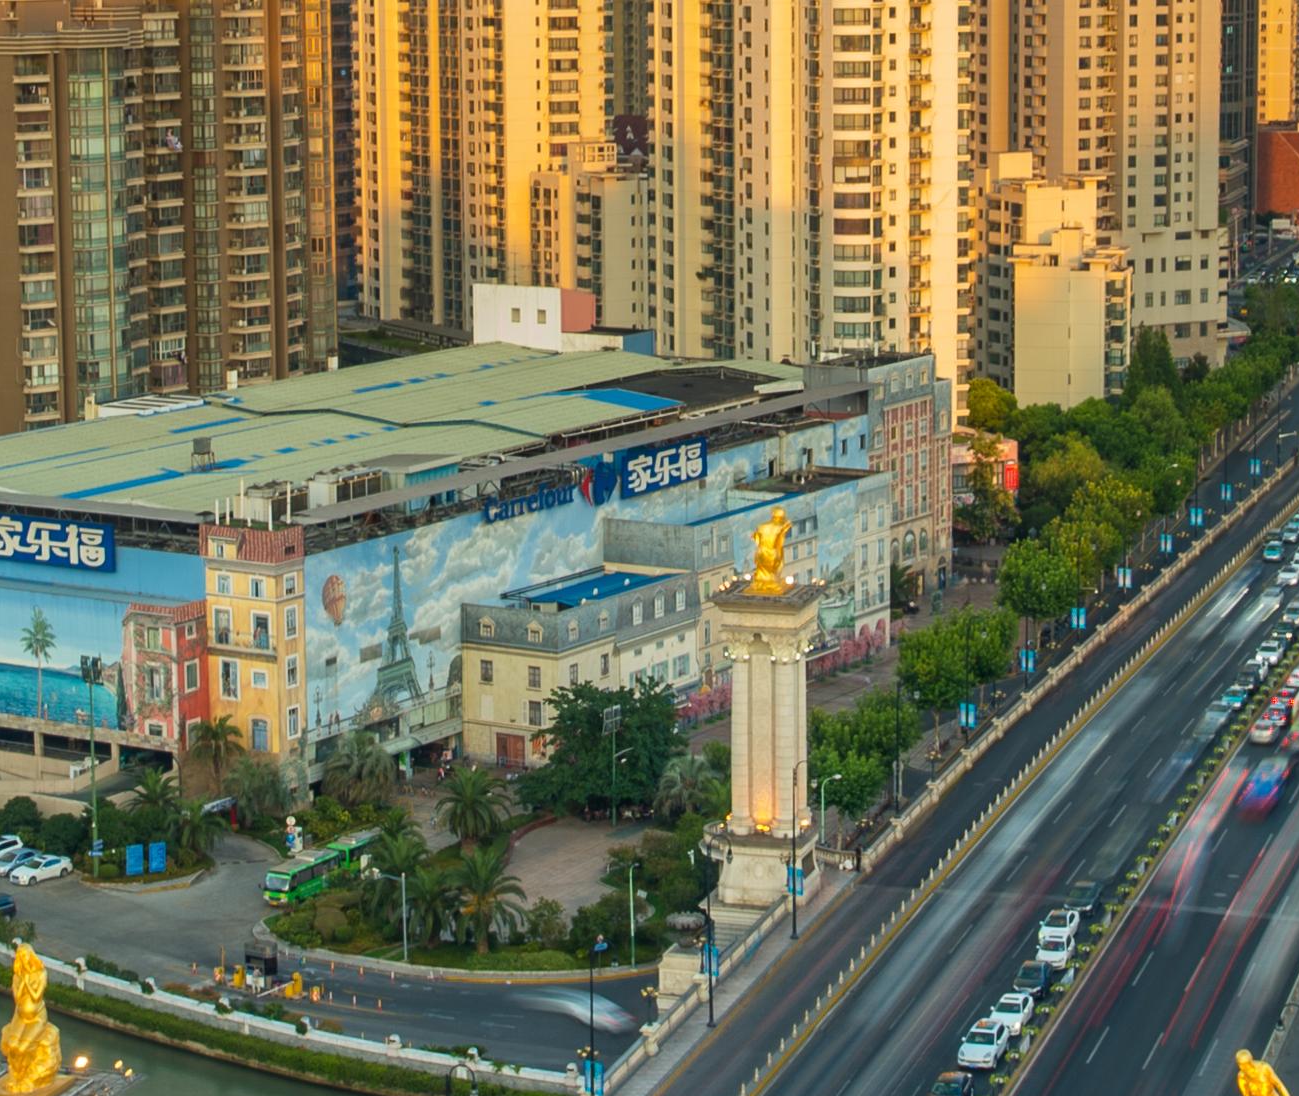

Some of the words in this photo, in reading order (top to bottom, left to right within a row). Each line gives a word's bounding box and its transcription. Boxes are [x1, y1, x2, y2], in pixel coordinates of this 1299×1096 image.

[626, 443, 703, 493] 家乐福
[483, 483, 577, 524] Carrefour
